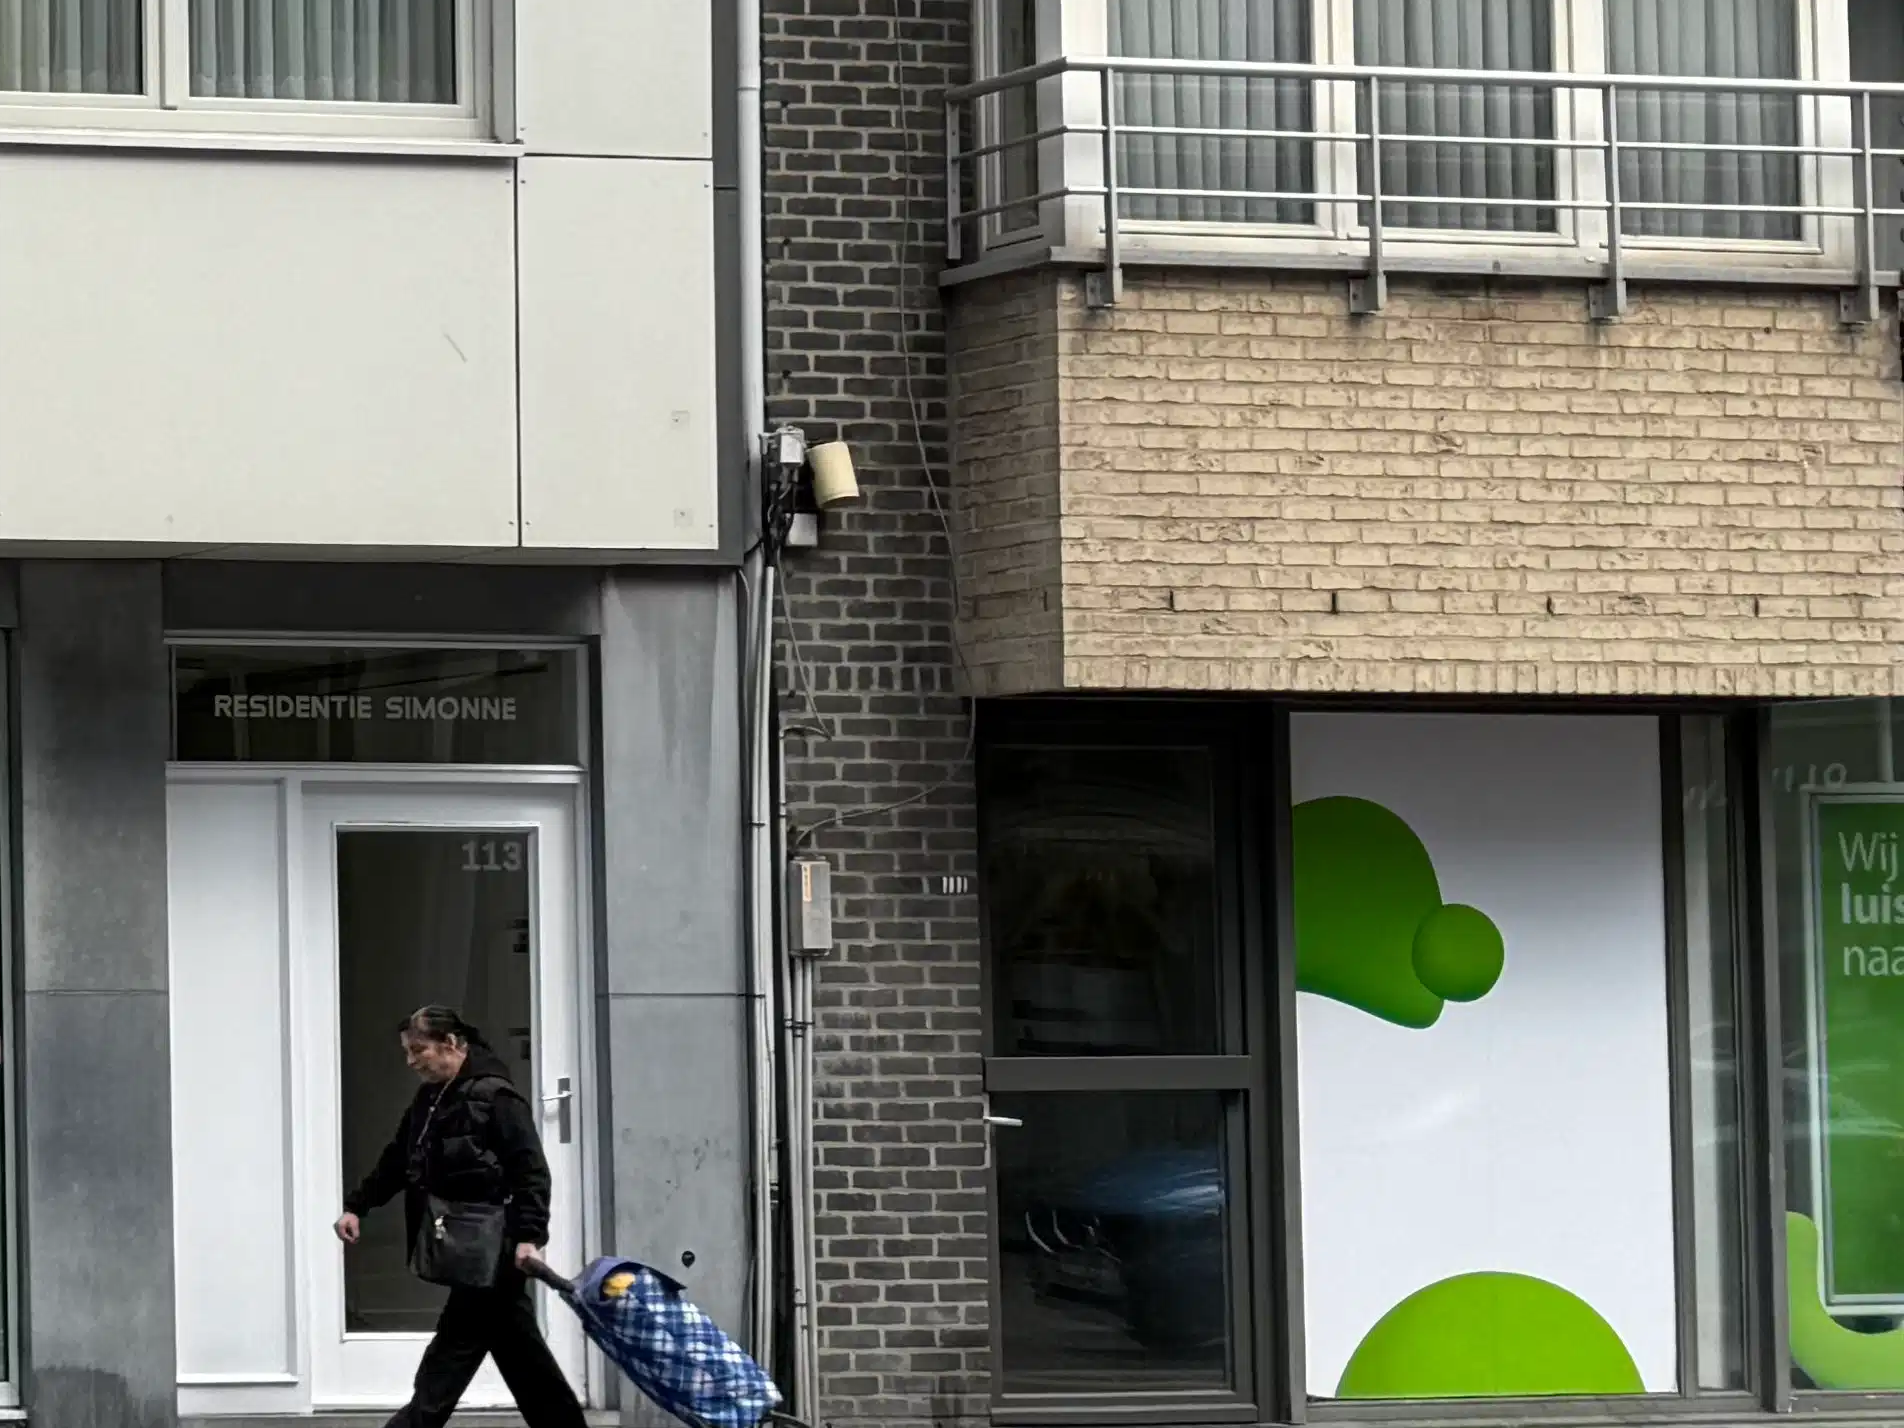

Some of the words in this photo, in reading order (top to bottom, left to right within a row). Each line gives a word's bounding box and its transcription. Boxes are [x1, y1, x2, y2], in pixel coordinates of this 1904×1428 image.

[214, 694, 372, 719] RESIDENTIE
[385, 696, 517, 720] SIMONNE
[460, 839, 523, 871] 113
[1838, 831, 1898, 882] Wij
